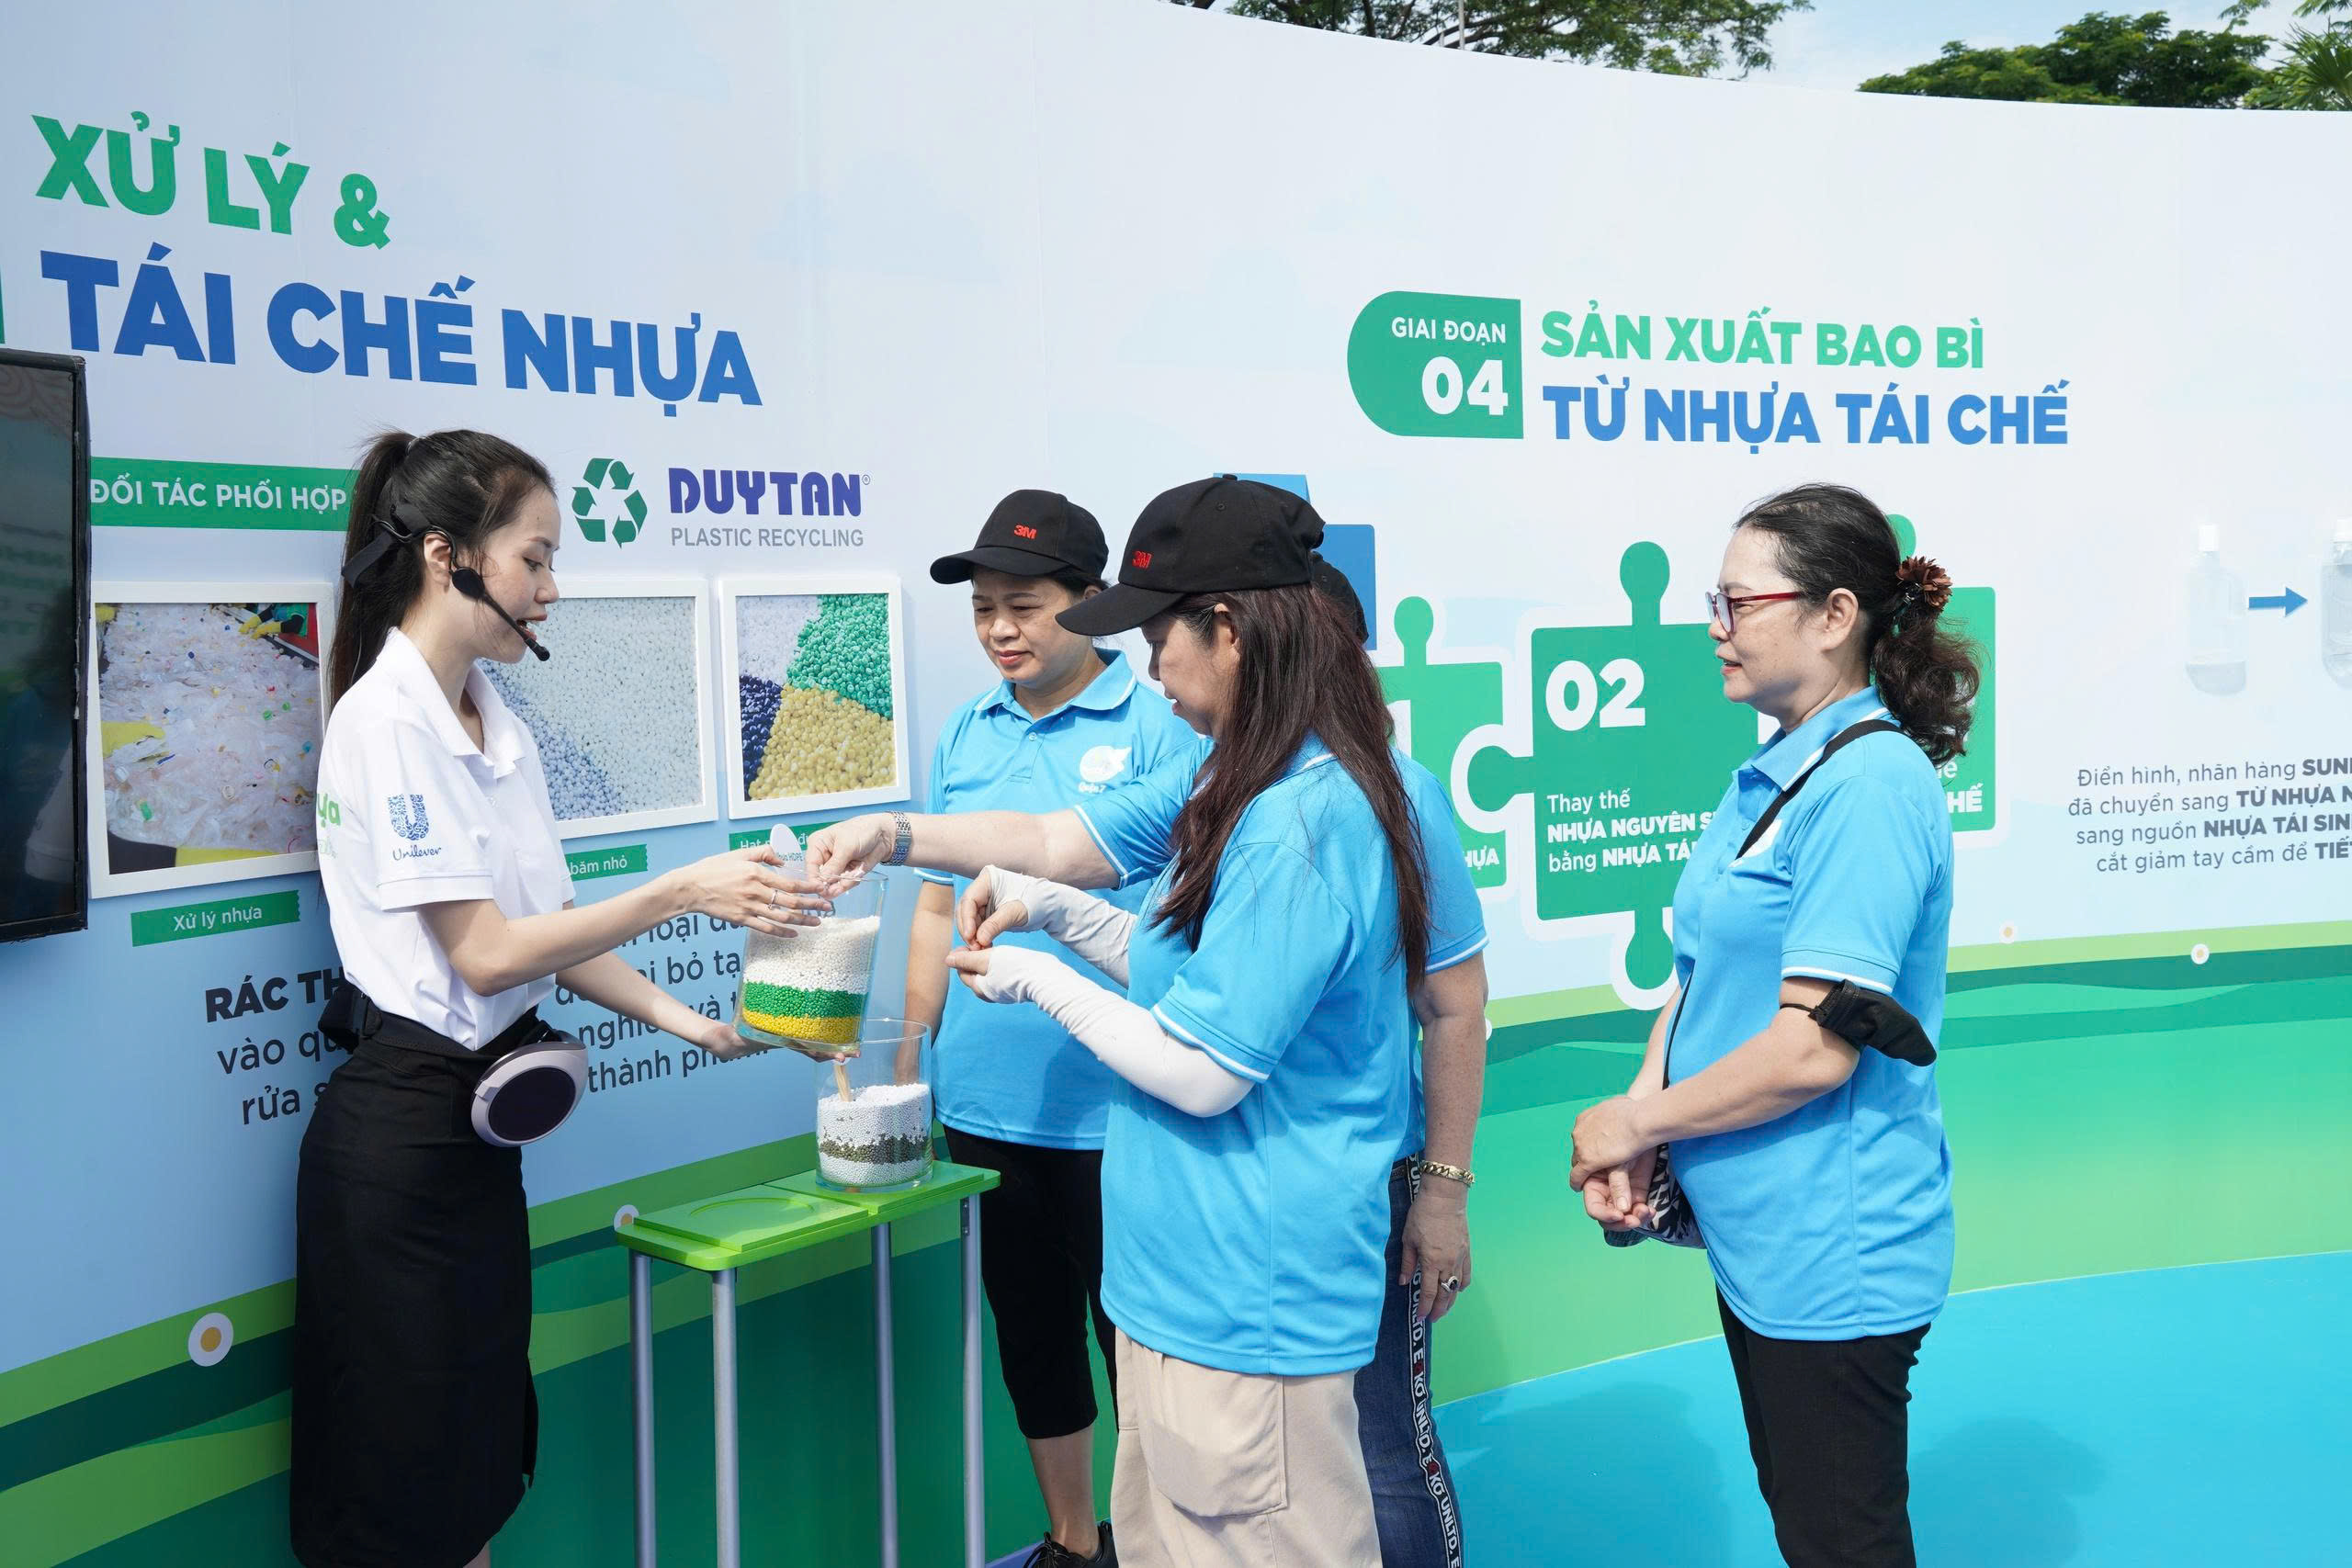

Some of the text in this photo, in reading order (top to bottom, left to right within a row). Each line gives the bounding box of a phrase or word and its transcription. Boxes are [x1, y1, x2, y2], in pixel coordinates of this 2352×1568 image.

[31, 110, 391, 250] XỬ LÝ &
[40, 242, 763, 417] TÁI CHẾ NHỰA
[1391, 317, 1507, 346] GIAI ĐOẠN
[1540, 299, 1984, 368] SẢN XUẤT BAO BÌ
[1421, 355, 1509, 416] 04
[1543, 374, 2070, 455] TỪ NHỰA TÁI CHẾ
[90, 472, 347, 514] ĐỐI TÁC PHỐI HỢP
[671, 527, 864, 547] PLASTIC RECYCLING
[1013, 523, 1037, 540] 3M
[1132, 550, 1153, 569] 3M
[1545, 658, 1646, 732] 02
[2077, 758, 2352, 786] Điển hình, nhãn hàng SUN
[1546, 788, 1631, 815] Thay thế
[1947, 783, 1984, 814] HẾ
[2068, 797, 2092, 816] đã
[2099, 792, 2174, 817] chuyển
[2181, 795, 2229, 813] sang
[2236, 785, 2267, 807] TỪ
[2271, 784, 2336, 807] NHỰA
[1547, 818, 1607, 844] NHỰA
[1611, 810, 1696, 838] NGUYÊN
[2076, 812, 2352, 846] sang nguồn NHỰA TÁI SIN
[392, 844, 442, 862] Unilever
[570, 854, 628, 875] băm nhỏ
[1464, 845, 1499, 872] HỰA
[1548, 851, 1597, 873] bằng
[1602, 842, 1661, 868] NHỰA
[2097, 852, 2128, 873] cắt
[2134, 851, 2185, 874] giảm
[2193, 849, 2224, 869] tay
[2282, 841, 2308, 862] để
[2314, 835, 2352, 860] TIẾ
[174, 906, 263, 931] Xử lý nhựa
[205, 975, 289, 1023] RÁC
[217, 1037, 285, 1075] vào
[667, 952, 704, 985] bỏ
[713, 950, 741, 978] tạ
[588, 1049, 671, 1093] thành
[242, 1085, 300, 1125] rửa
